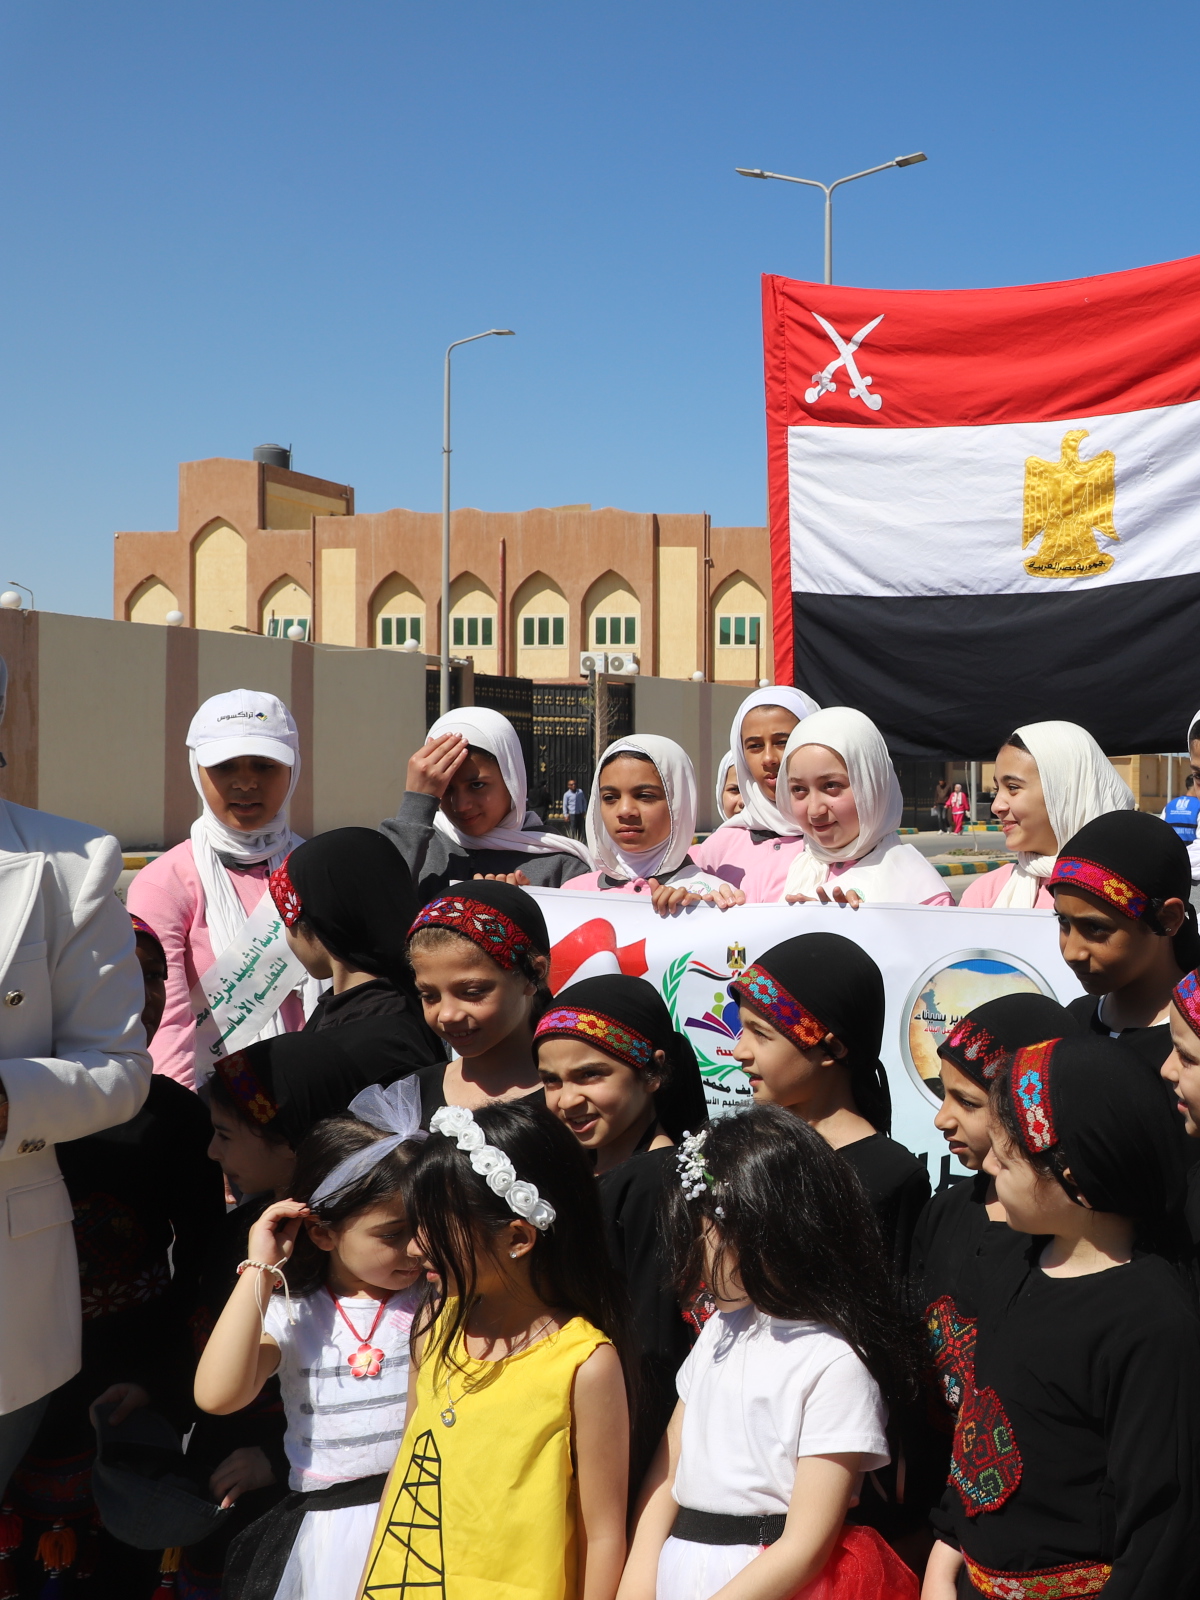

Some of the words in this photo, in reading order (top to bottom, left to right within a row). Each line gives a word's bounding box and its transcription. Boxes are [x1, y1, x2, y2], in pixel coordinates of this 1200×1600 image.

[216, 711, 254, 723] تراكسوس
[252, 920, 282, 948] مدرسة
[232, 944, 264, 983] الشهيد
[208, 977, 237, 1010] شريف
[253, 957, 288, 1005] للتعليم
[209, 998, 257, 1057] الأساسي
[914, 1009, 947, 1024] سيناء
[702, 1078, 732, 1094] محمد
